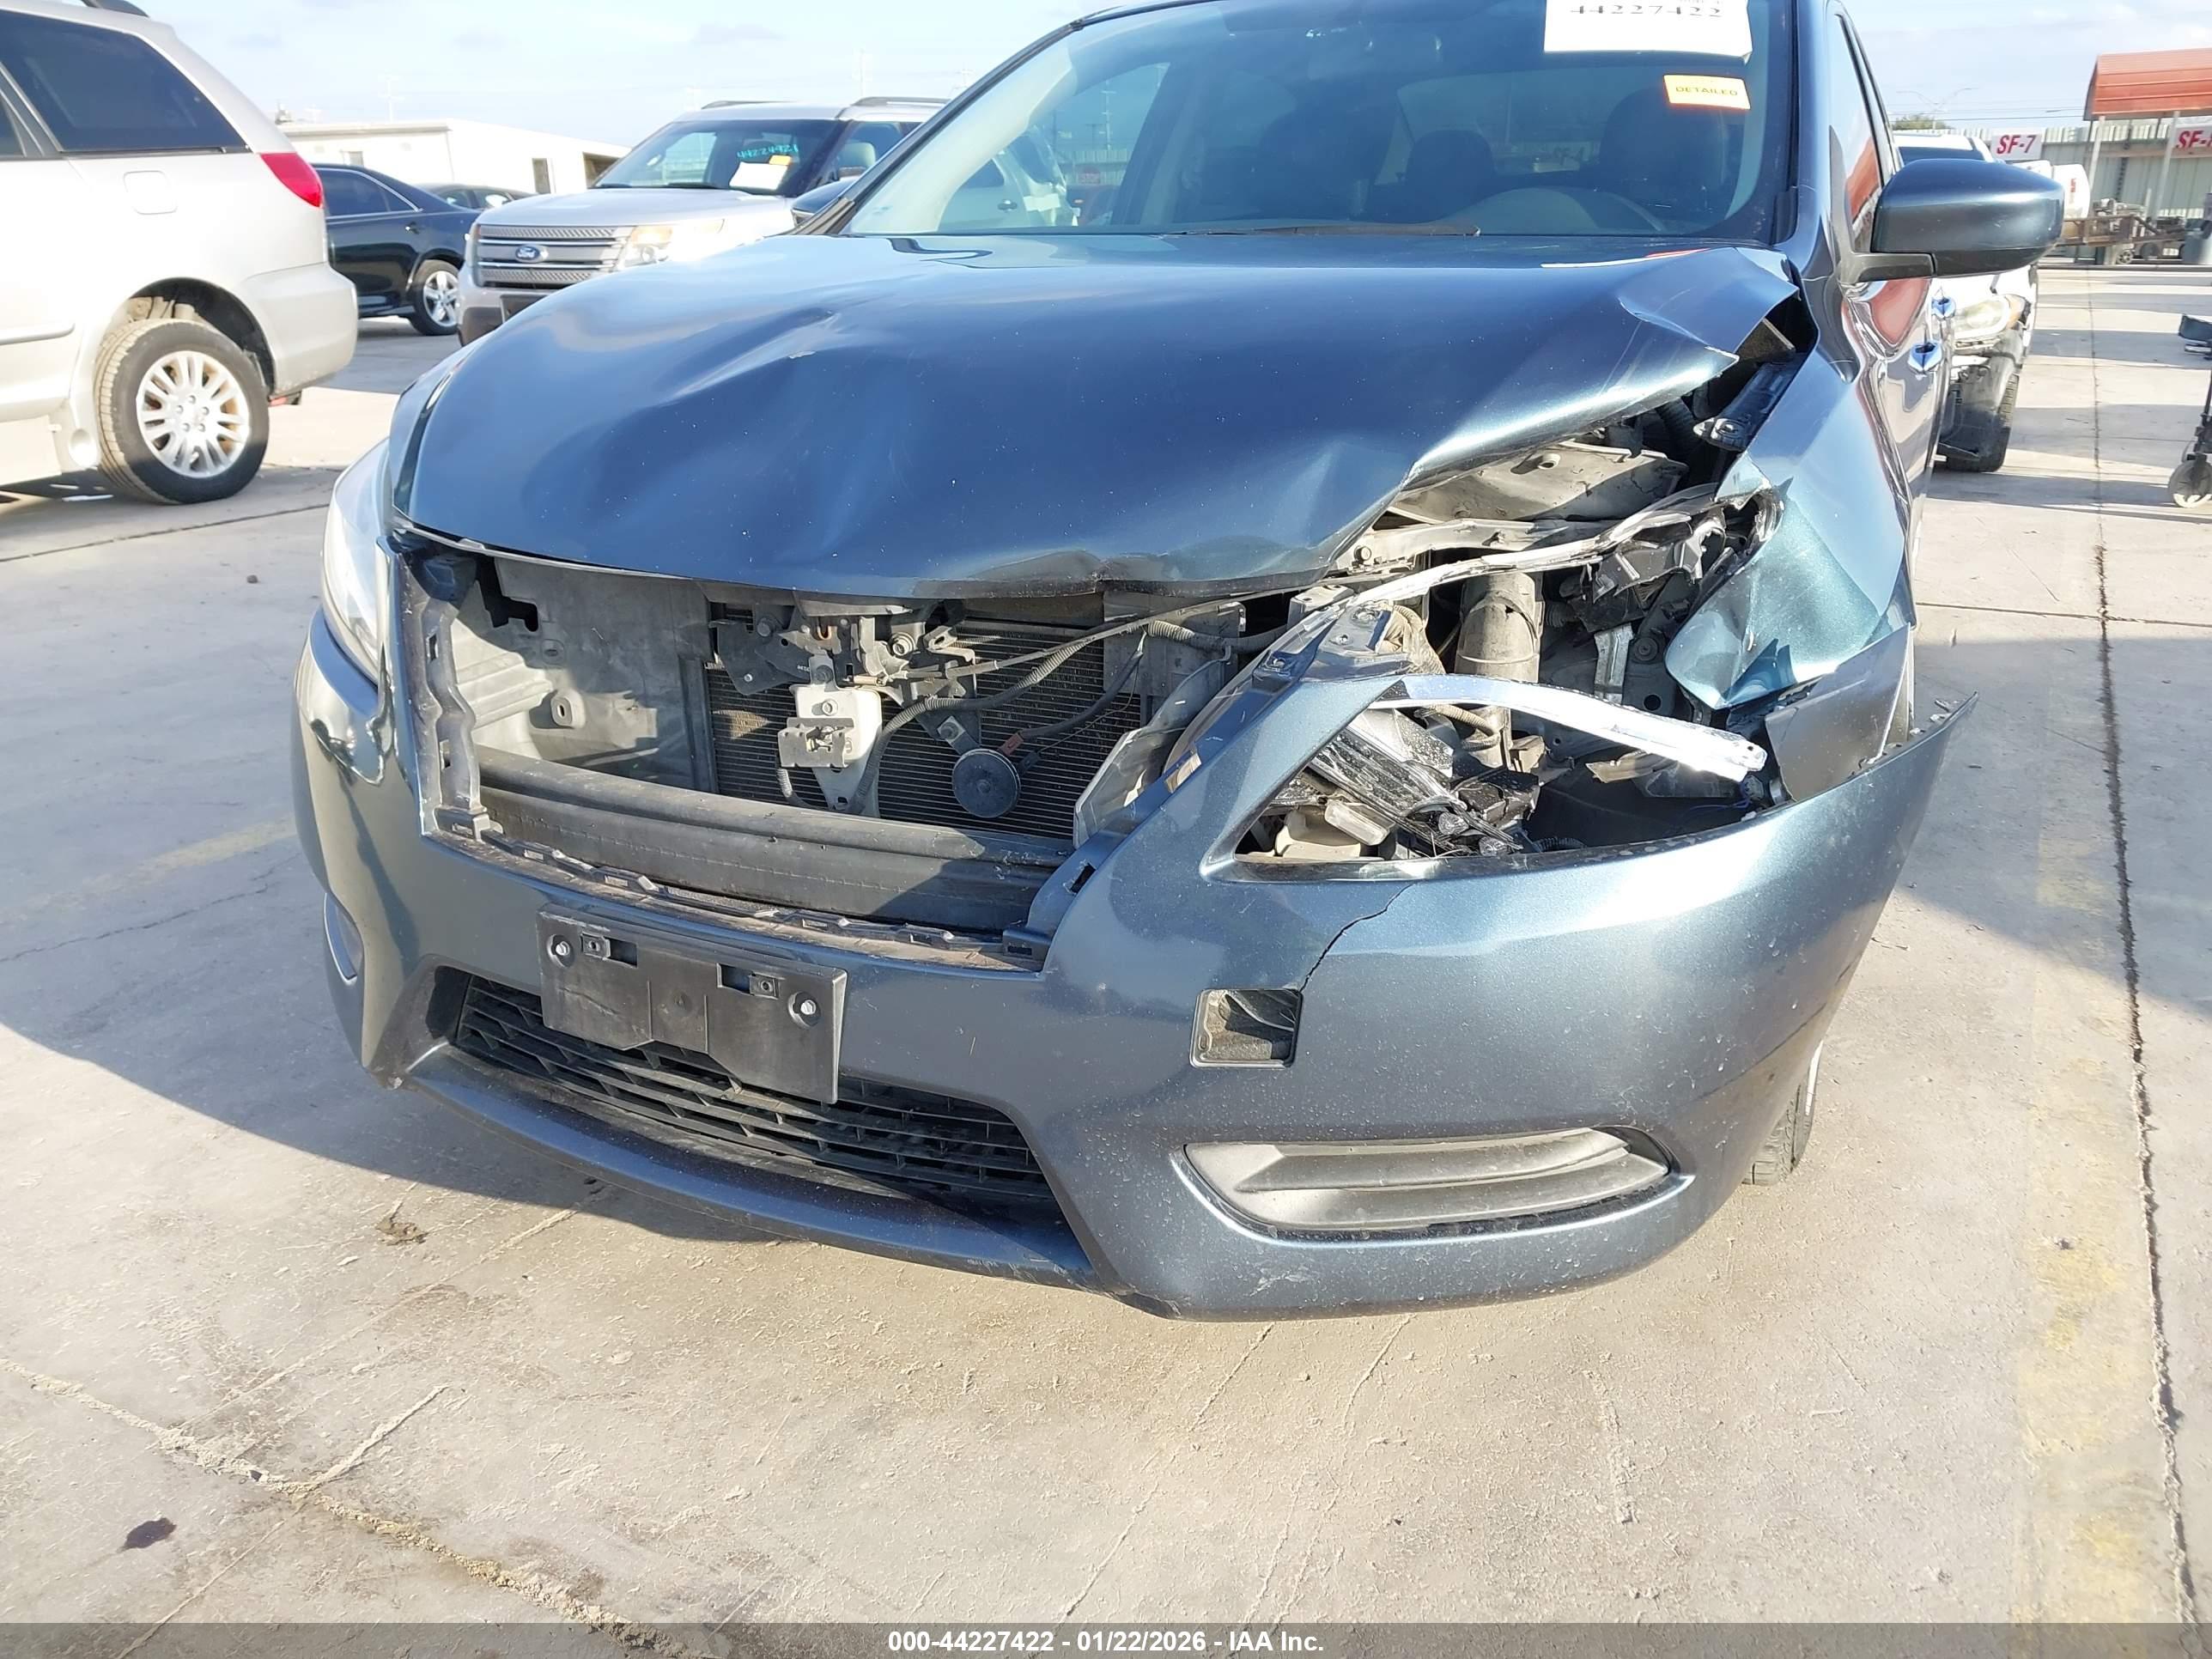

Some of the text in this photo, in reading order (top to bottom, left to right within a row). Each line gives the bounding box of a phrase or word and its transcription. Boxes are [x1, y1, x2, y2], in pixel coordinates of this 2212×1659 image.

[1570, 5, 1722, 17] 44227422
[1675, 86, 1738, 96] DETAILED
[1996, 134, 2037, 155] SF-7
[517, 246, 538, 258] Ford
